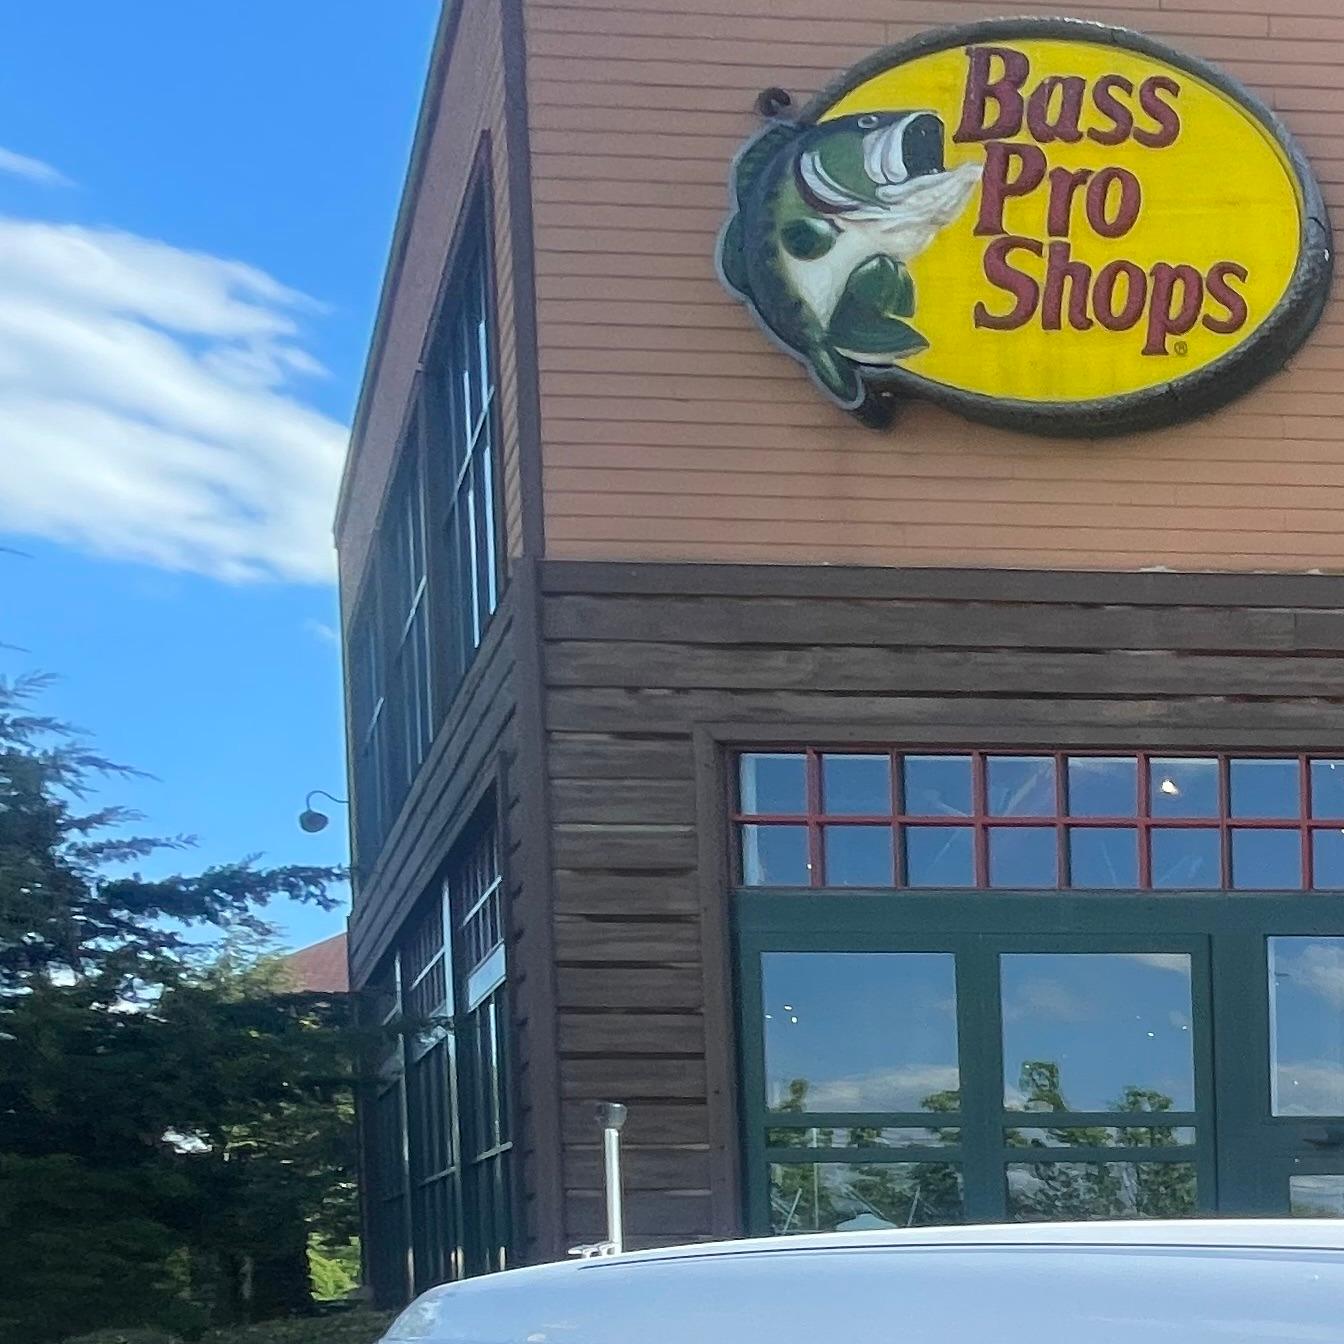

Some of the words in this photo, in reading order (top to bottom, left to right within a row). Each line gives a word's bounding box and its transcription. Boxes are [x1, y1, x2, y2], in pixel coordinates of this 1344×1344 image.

[952, 46, 1181, 149] Bass
[974, 141, 1141, 239] Pro
[974, 236, 1249, 355] Shops
